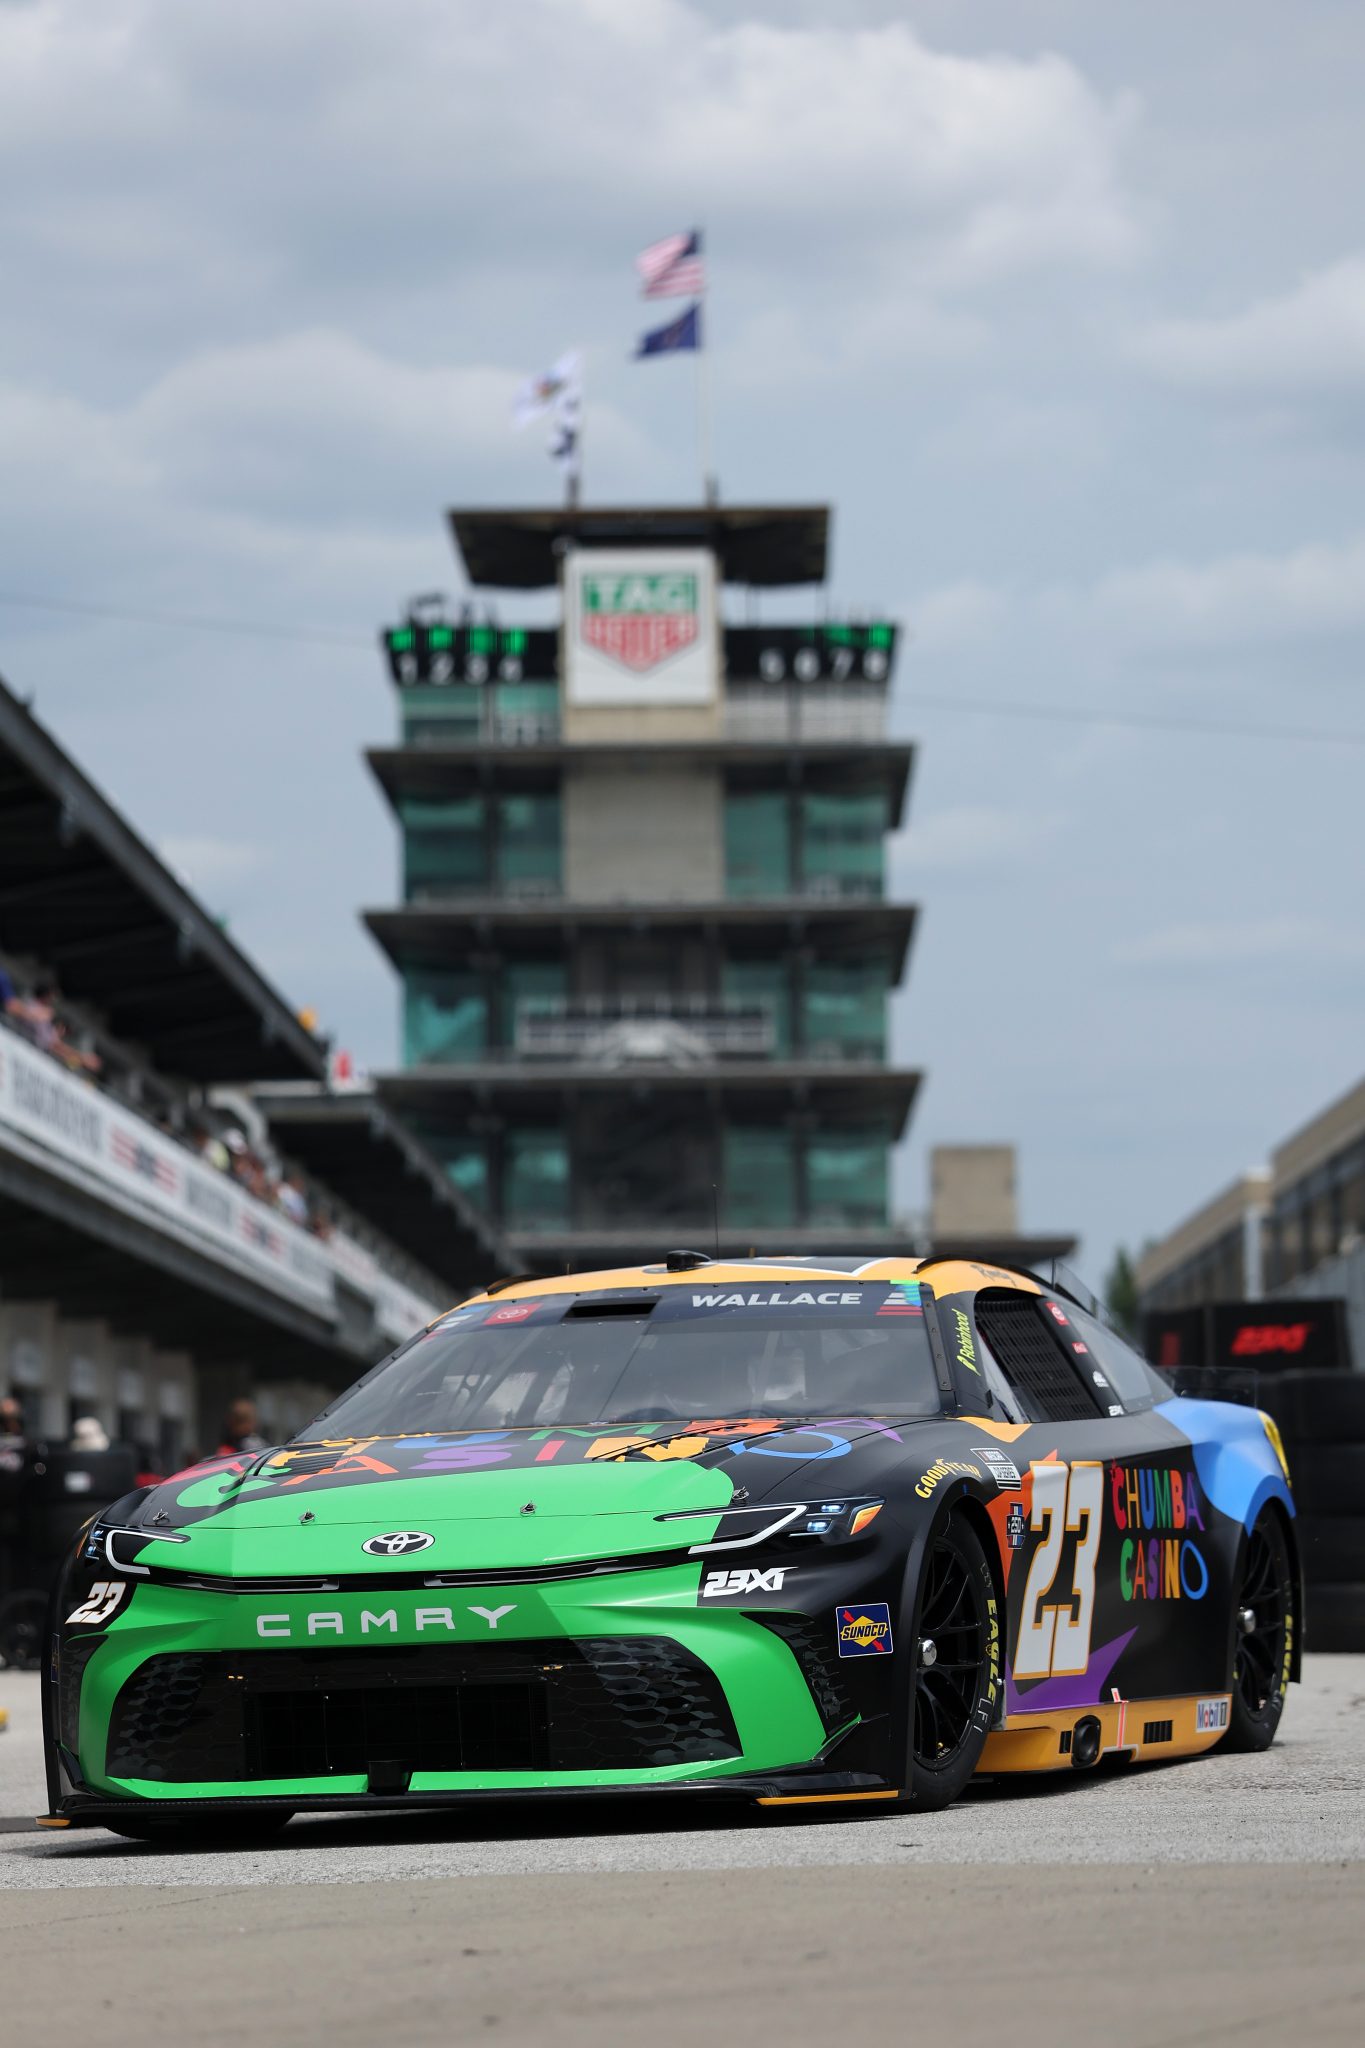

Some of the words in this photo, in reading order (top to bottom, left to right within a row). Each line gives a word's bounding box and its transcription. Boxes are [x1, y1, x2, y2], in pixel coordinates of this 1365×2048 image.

[691, 1292, 863, 1307] WALLACE
[951, 1308, 976, 1362] Robinhood
[914, 1458, 983, 1499] GOODYEAR
[1111, 1460, 1206, 1531] CHUMBA
[1012, 1460, 1104, 1680] 23
[1119, 1538, 1209, 1602] CASINO
[64, 1582, 127, 1625] 23
[256, 1604, 517, 1637] CAMRY
[842, 1623, 887, 1640] SUNOCO
[986, 1599, 1000, 1708] EAGLE
